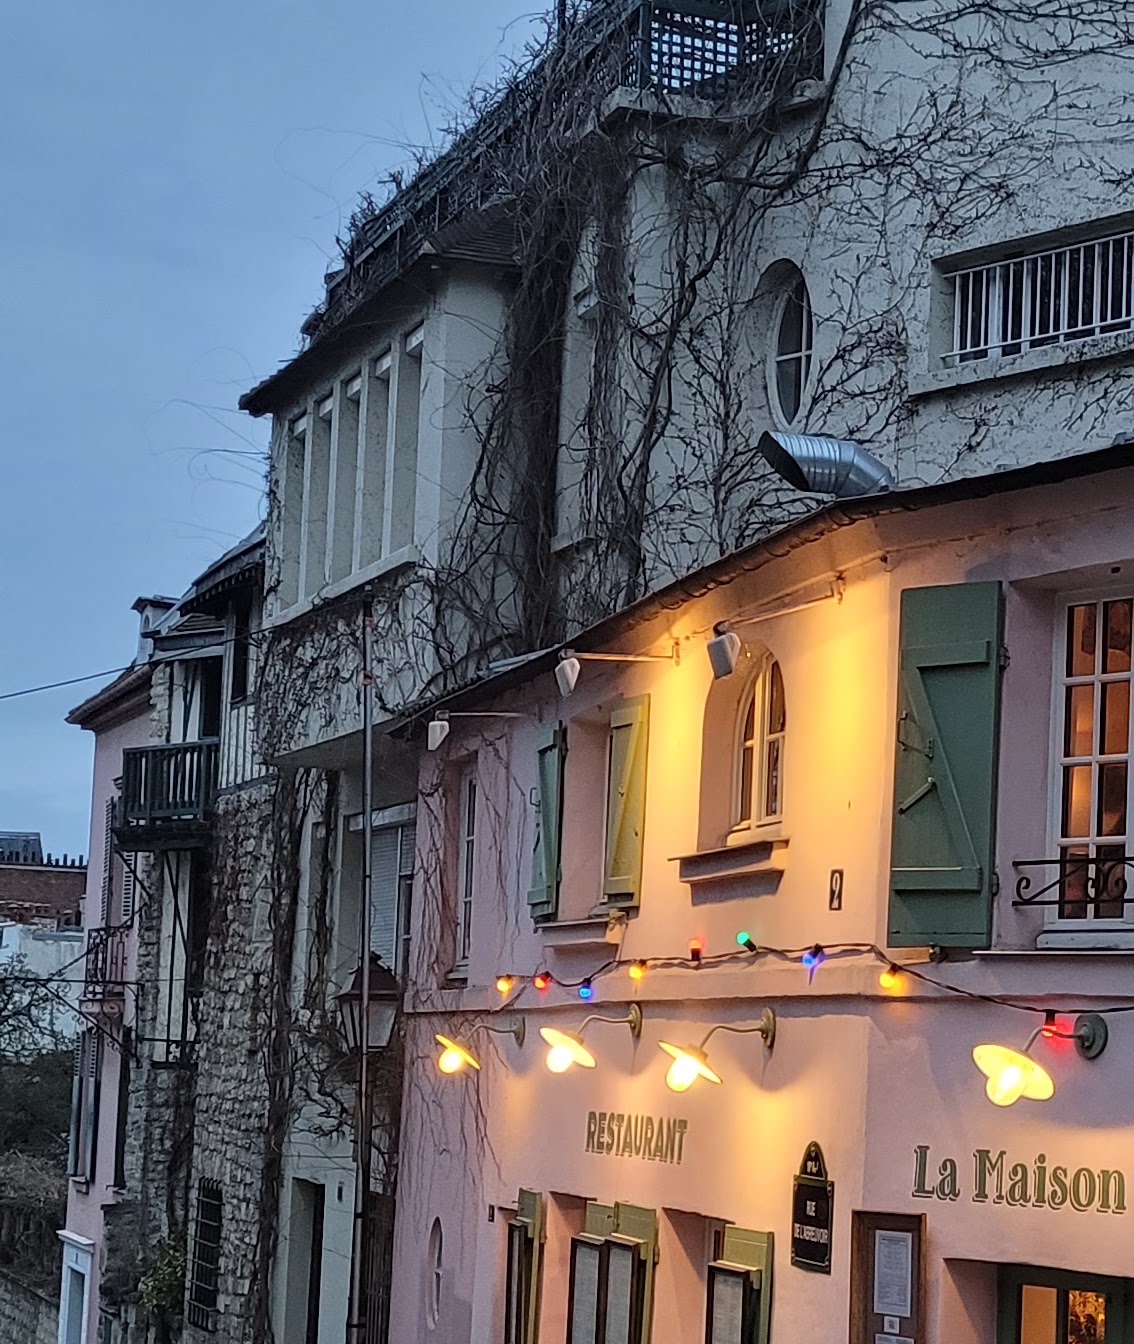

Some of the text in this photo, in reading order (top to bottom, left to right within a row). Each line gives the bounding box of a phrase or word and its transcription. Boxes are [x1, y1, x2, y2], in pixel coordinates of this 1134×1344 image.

[831, 872, 841, 909] 2
[584, 1110, 688, 1166] RESTAURANT
[911, 1144, 961, 1201] La
[971, 1147, 1127, 1216] Maison
